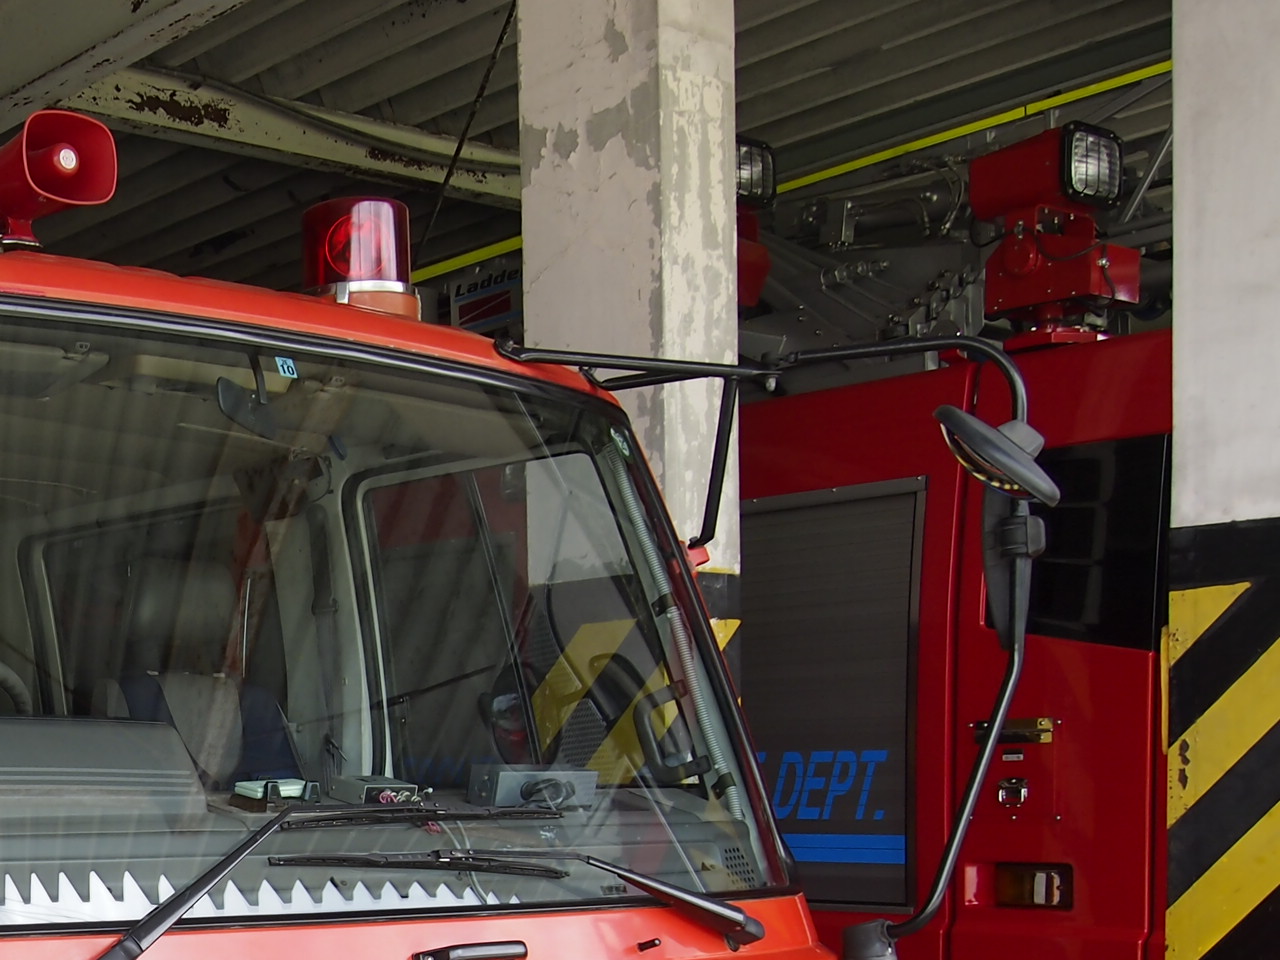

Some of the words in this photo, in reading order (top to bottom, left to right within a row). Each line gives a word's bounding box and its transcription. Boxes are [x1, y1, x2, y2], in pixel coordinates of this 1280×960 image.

[455, 269, 519, 297] Ladde
[280, 364, 295, 376] 10
[773, 749, 889, 820] DEPT.
